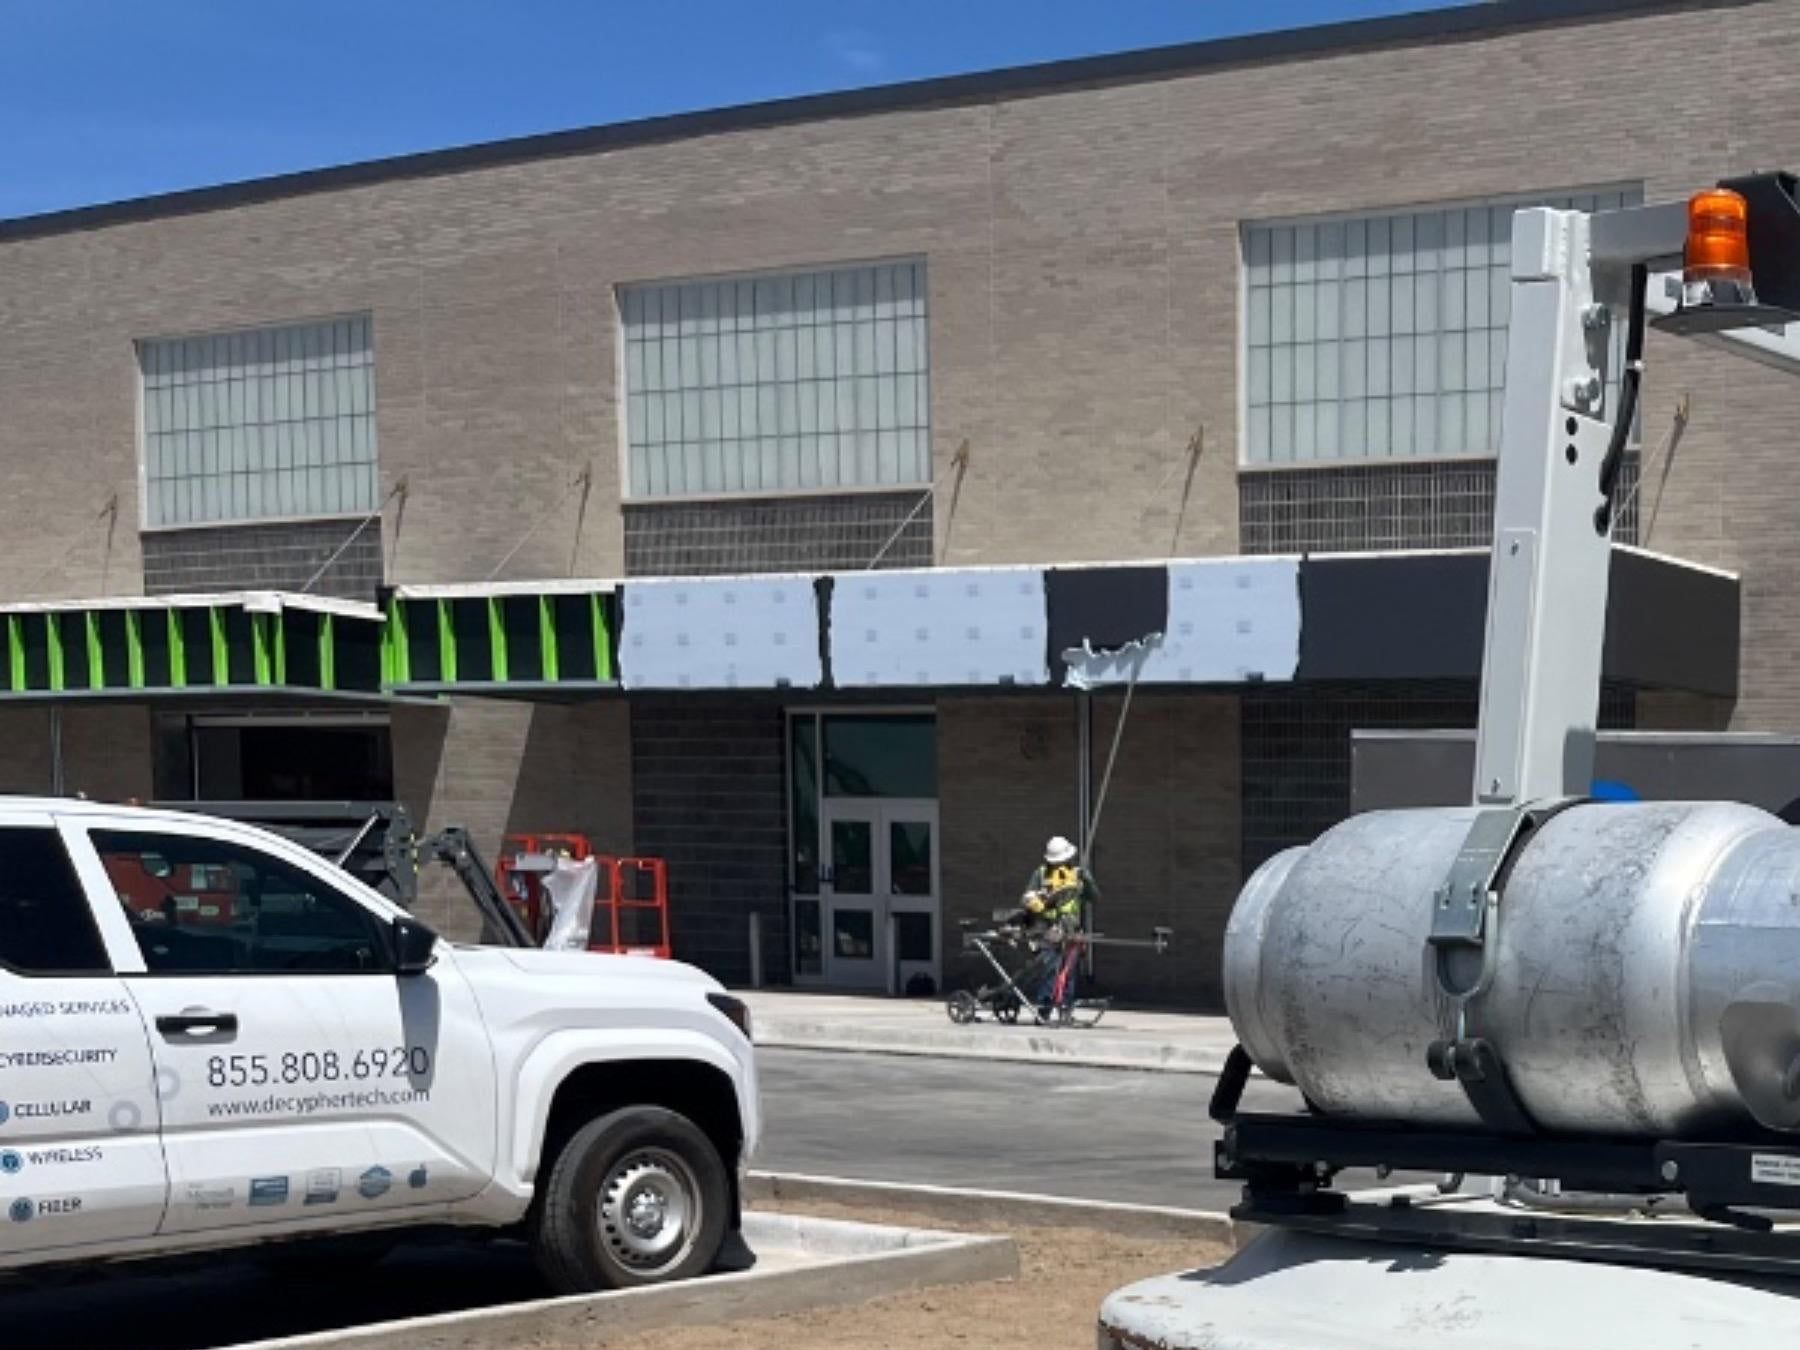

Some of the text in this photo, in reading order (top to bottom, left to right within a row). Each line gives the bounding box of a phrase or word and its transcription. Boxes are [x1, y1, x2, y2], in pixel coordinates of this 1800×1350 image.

[59, 999, 130, 1015] SERVICES
[208, 1047, 430, 1087] 855.808.6920
[15, 1099, 91, 1117] CELLULAR
[207, 1088, 430, 1117] www.decyphertech.com
[28, 1145, 103, 1165] WIRELESS
[39, 1197, 83, 1215] FIBER
